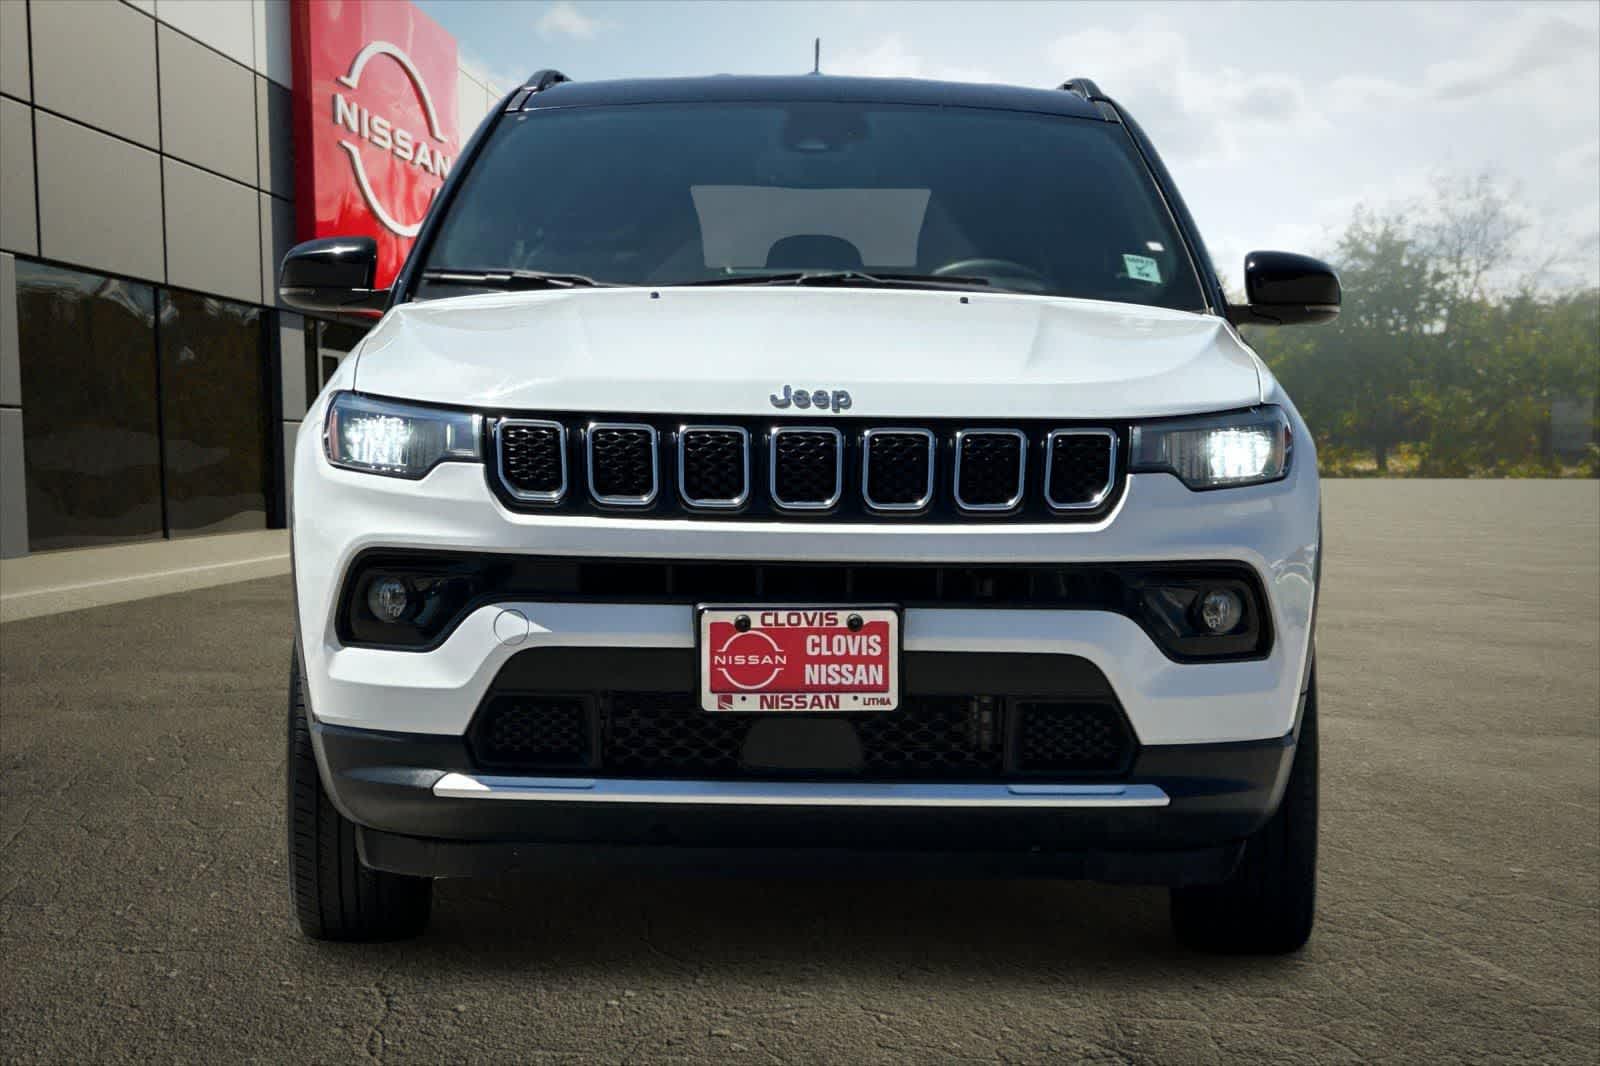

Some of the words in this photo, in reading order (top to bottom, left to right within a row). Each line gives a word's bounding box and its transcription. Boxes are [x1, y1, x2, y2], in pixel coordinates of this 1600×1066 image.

[333, 93, 451, 180] NISSAN
[769, 384, 852, 414] Jeep
[760, 612, 839, 627] CLOVIS
[806, 635, 882, 656] CLOVIS
[714, 655, 787, 665] NISSAN
[805, 664, 883, 685] NISSAN
[759, 695, 840, 710] NISSAN
[863, 697, 892, 706] LITHIA
